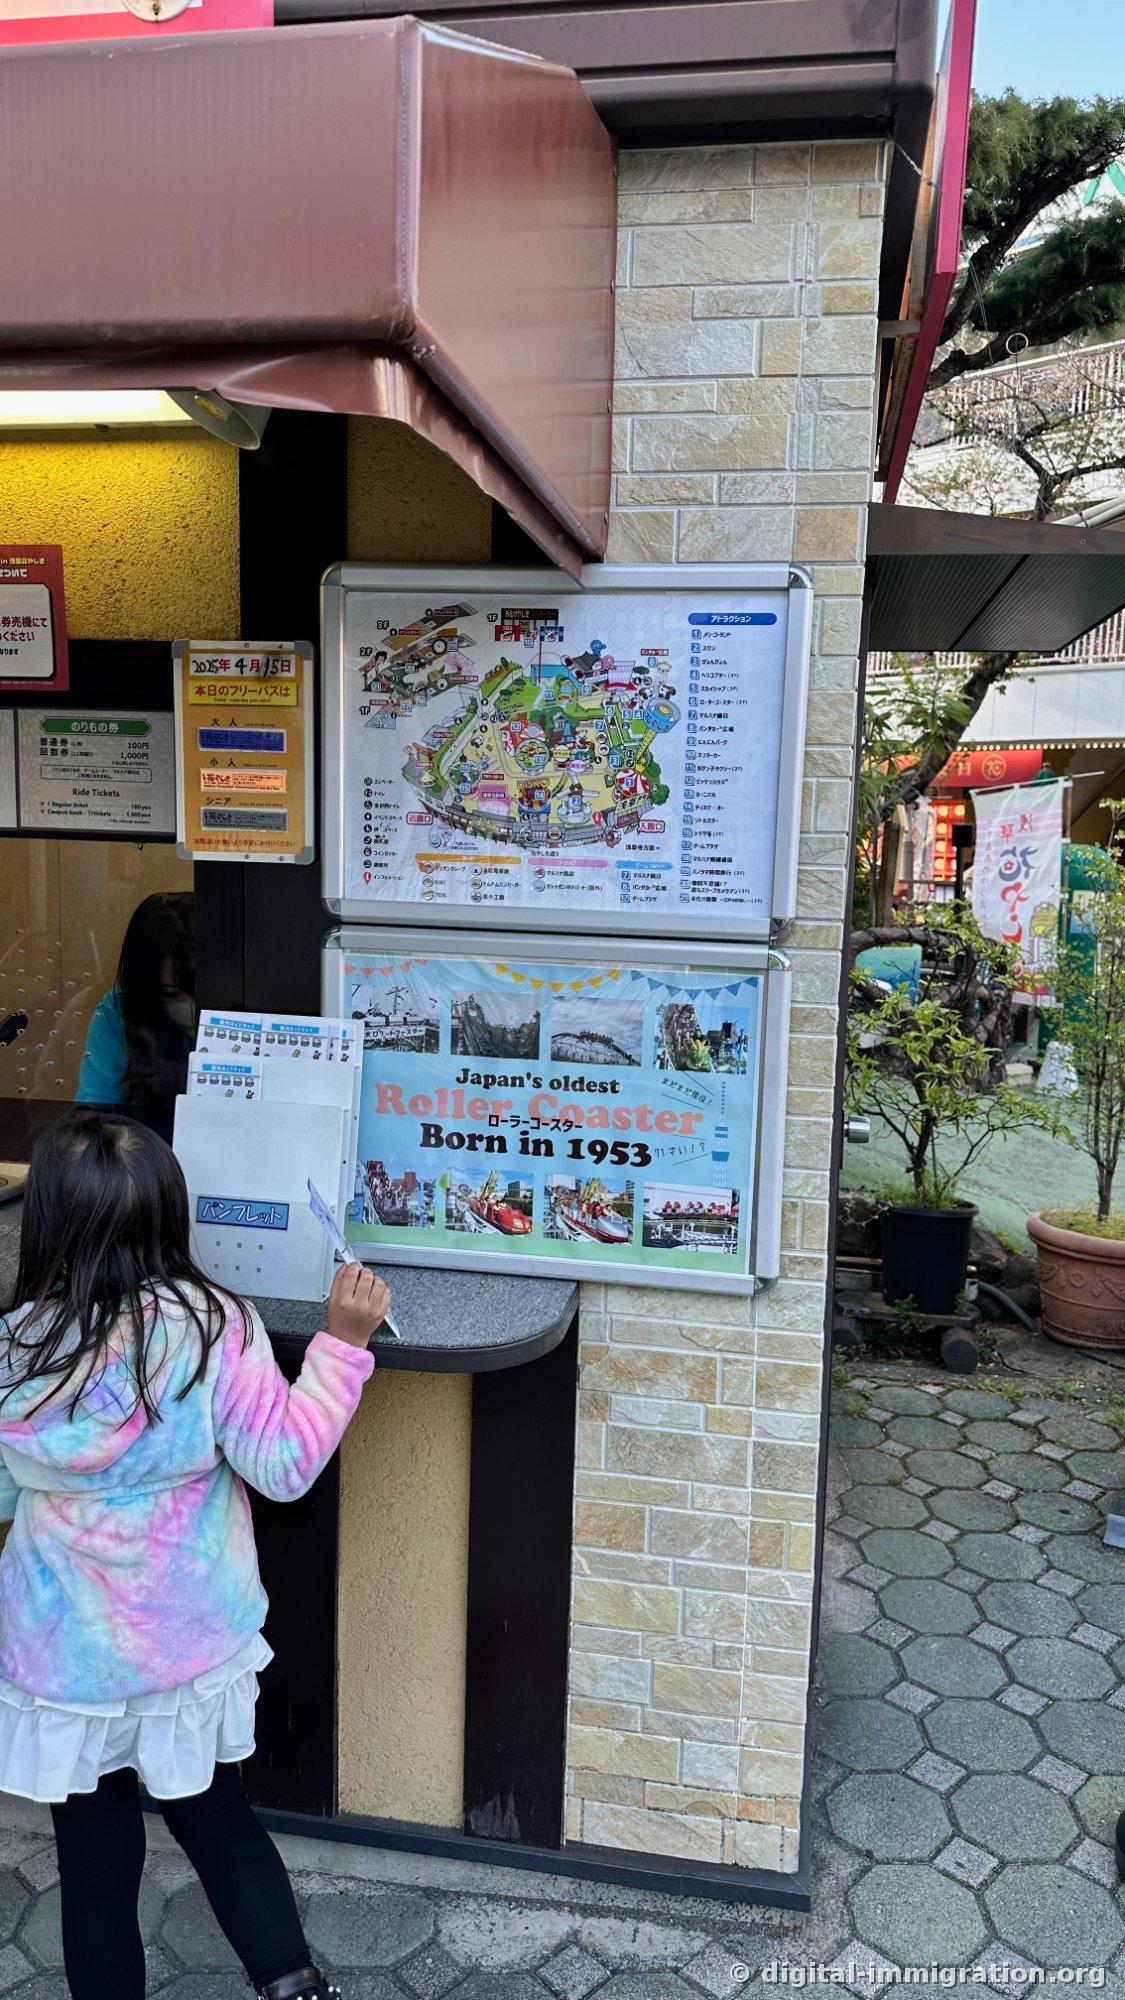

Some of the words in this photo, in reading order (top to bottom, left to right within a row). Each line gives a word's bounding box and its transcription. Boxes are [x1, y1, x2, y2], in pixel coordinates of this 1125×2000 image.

[487, 613, 498, 622] 1F
[377, 621, 389, 629] 3F
[360, 648, 372, 656] 2F
[196, 685, 290, 697] 本日のフリーパスは
[360, 706, 370, 715] 1F
[71, 722, 119, 733] のりもの券
[72, 788, 90, 796] Ride
[92, 789, 120, 797] Tickets
[206, 798, 231, 806] シニア
[456, 1068, 542, 1089] Japan's
[550, 1076, 620, 1094] oldest
[375, 1083, 513, 1120] Roller
[528, 1093, 704, 1135] Coaster
[488, 1114, 583, 1133] ローラーコースター
[420, 1122, 508, 1153] Born
[519, 1130, 555, 1157] in
[568, 1138, 652, 1167] 1953
[202, 1202, 282, 1224] パンフレット
